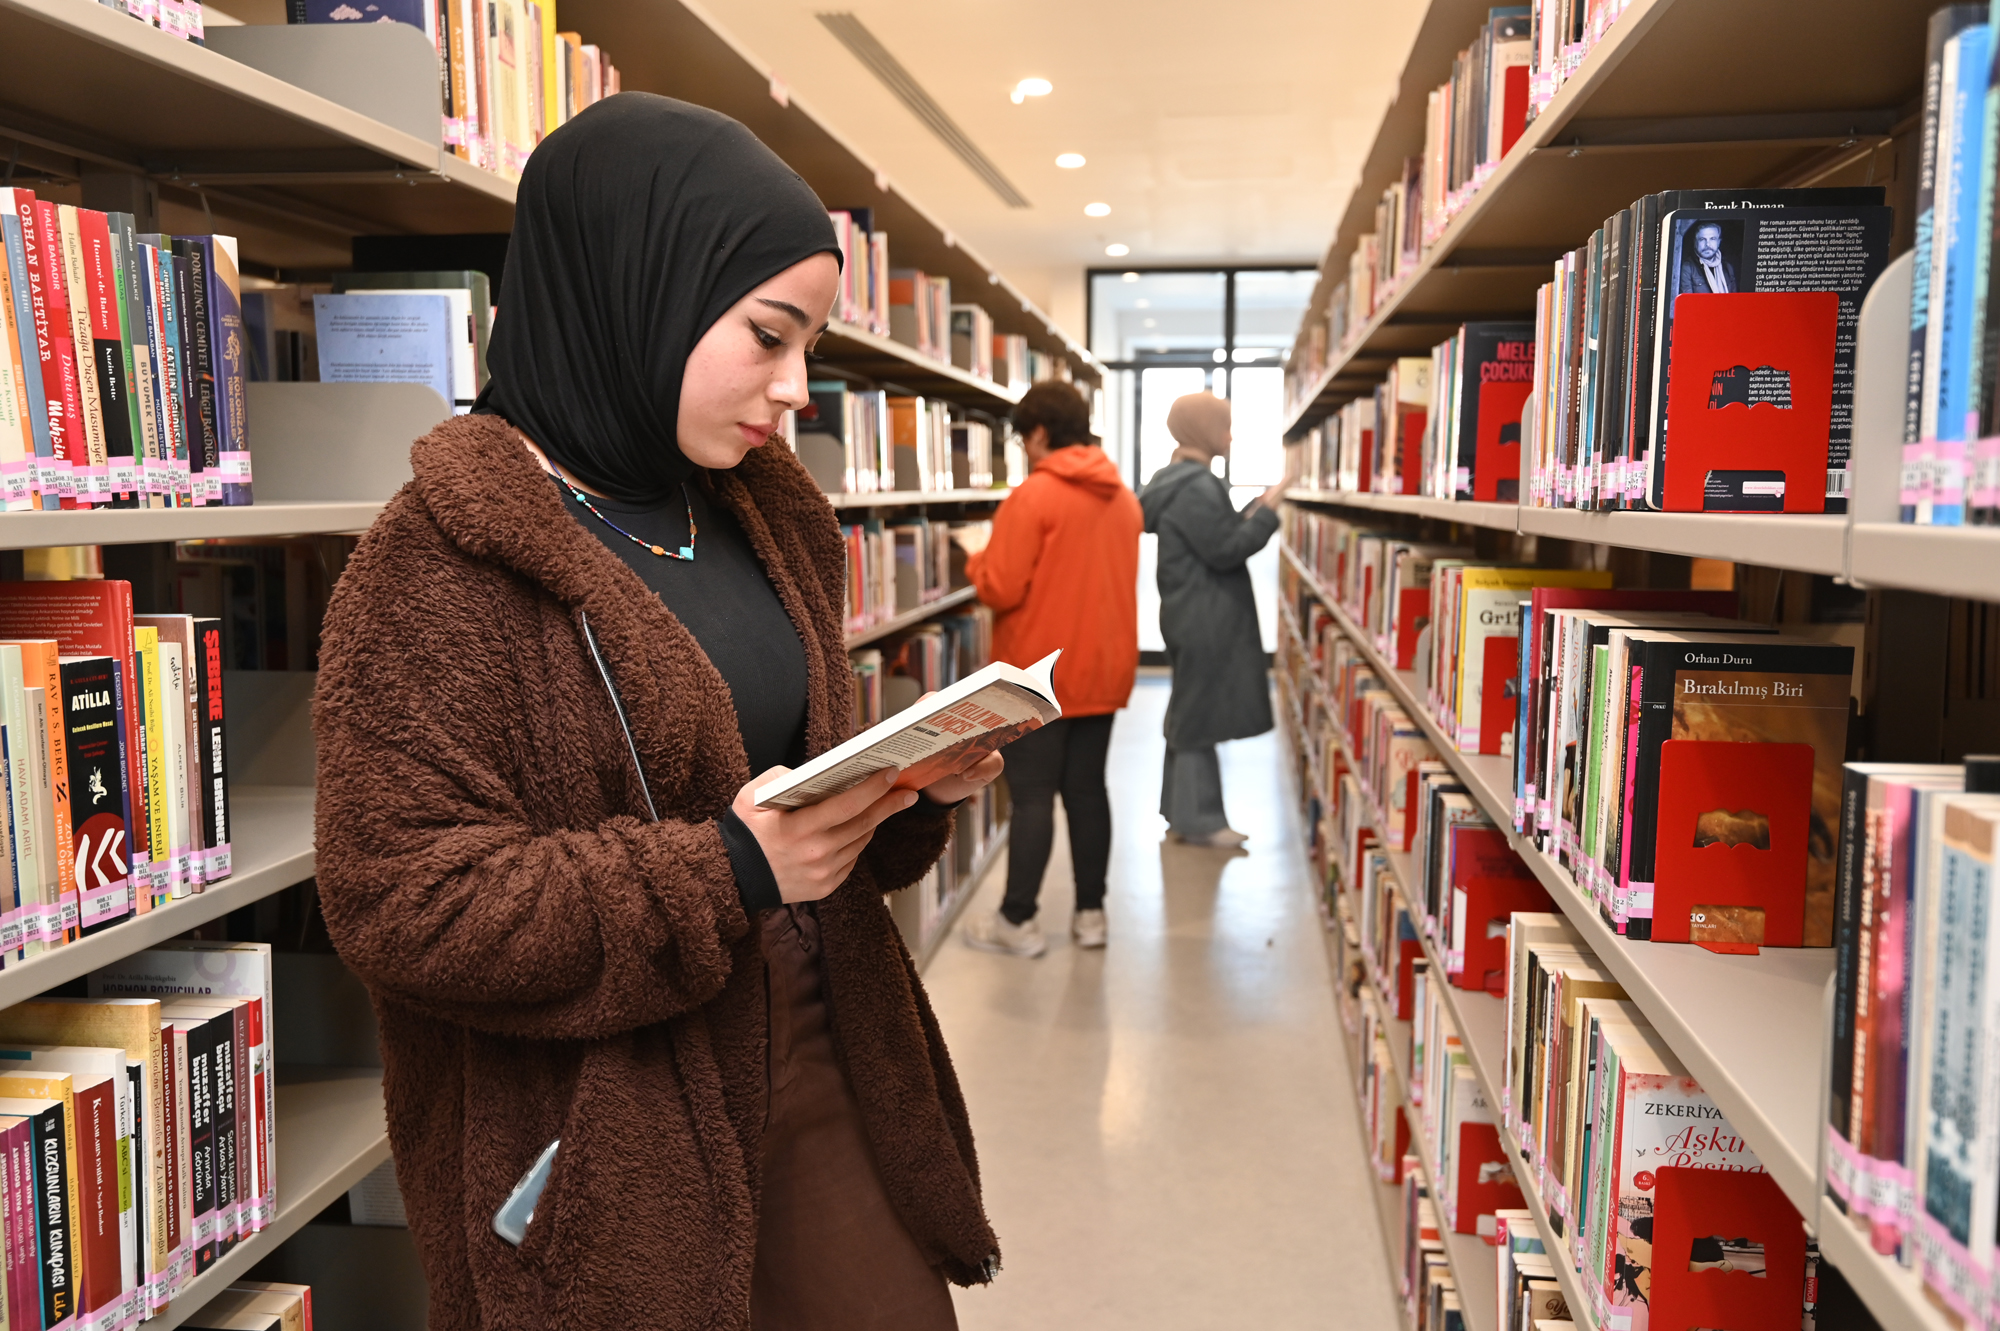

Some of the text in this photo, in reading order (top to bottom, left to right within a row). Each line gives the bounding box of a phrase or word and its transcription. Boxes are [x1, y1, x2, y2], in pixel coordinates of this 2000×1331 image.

[43, 208, 61, 290] HALİM BAHADIR
[68, 232, 81, 284] Halim Bahadır
[20, 204, 51, 361] ORHAN BAHTİYAR
[93, 239, 108, 330] Honoré de Balzac
[132, 274, 140, 301] BALKIZ
[191, 252, 208, 368] DOKUZUNCU CEMİYET
[106, 348, 114, 374] Kuzin
[166, 347, 177, 389] KATİLİN
[61, 353, 76, 419] Dokunuş
[77, 307, 104, 464] Tuzağa Düşen Masumiyet
[140, 361, 153, 417] BÜYÜMEK
[200, 383, 213, 416] LEIGH
[48, 400, 66, 461] Muhsin
[156, 399, 164, 432] MÜJDEMİ
[203, 629, 223, 721] ŞEBEKE
[1684, 653, 1753, 665] Orhan Duru
[72, 690, 110, 711] ATİLLA
[1683, 679, 1804, 699] Bırakılmış Biri
[49, 673, 64, 775] RAV P. S. BERG
[925, 712, 977, 736] KAMÇISI
[119, 741, 127, 760] JOHN
[17, 759, 32, 860] HAVA ADAMI ARİEL
[56, 812, 64, 846] Temel
[151, 757, 165, 856] YAŞAM VE ENERJİ
[97, 895, 112, 904] 808.31
[144, 975, 176, 983] Büyükgebiz
[192, 1055, 202, 1128] buyrukçu
[201, 1053, 210, 1123] muzaffer
[215, 1043, 225, 1114] buyrukçu
[224, 1040, 233, 1109] muzaffer
[119, 1095, 127, 1143] Türkçenin
[1644, 1102, 1724, 1120] ZEKERİYA
[12, 1147, 22, 1188] BOURGET
[23, 1141, 32, 1181] BOURGET
[204, 1146, 212, 1189] Anında
[227, 1129, 235, 1159] Sıcak
[1, 1153, 9, 1193] BOURGET
[195, 1151, 204, 1202] Görüntü
[218, 1136, 228, 1203] Arkası Yarın
[44, 1138, 65, 1288] KUZGUNLARIN KUMPASI
[157, 1198, 166, 1255] Feridunoğlu
[53, 1292, 66, 1321] Lila
[1806, 1278, 1815, 1301] ROMAN
